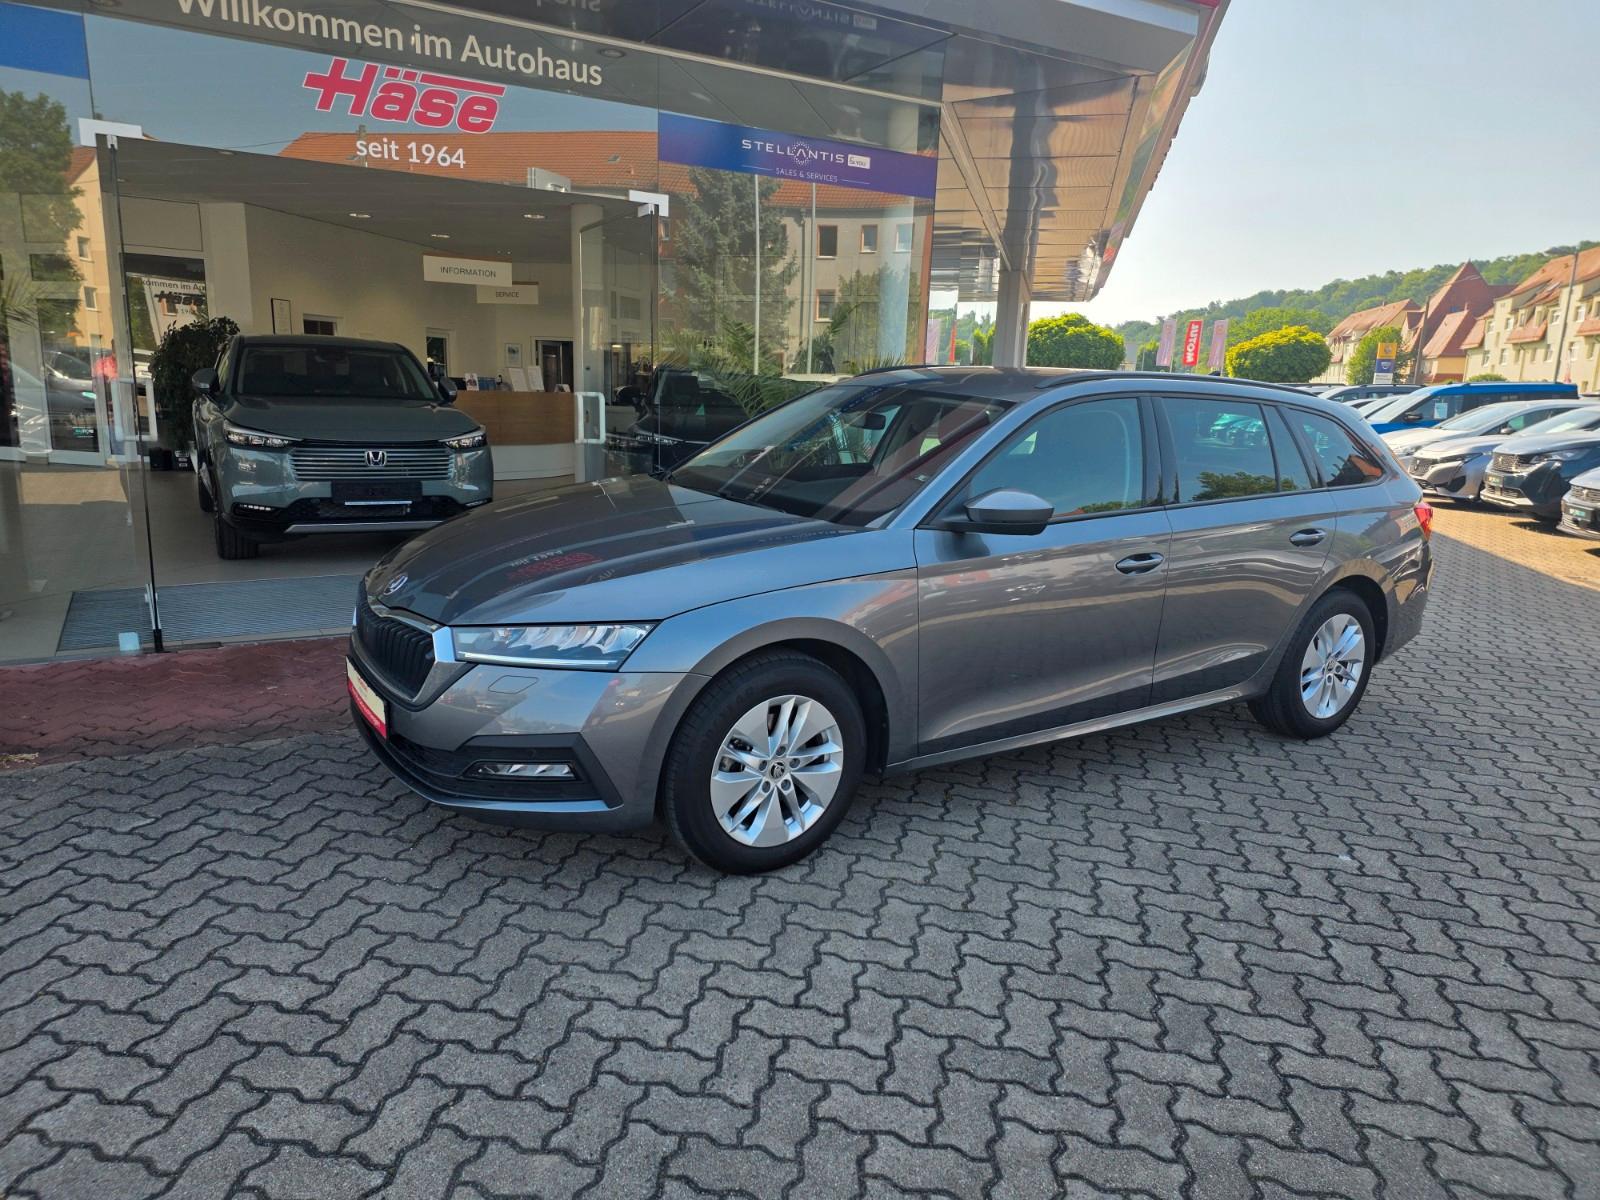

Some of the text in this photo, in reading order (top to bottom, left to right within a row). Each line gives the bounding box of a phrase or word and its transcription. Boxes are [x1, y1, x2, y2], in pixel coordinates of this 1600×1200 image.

[413, 24, 452, 60] im
[460, 34, 602, 86] Autohaus
[302, 56, 506, 134] Häse
[356, 137, 466, 168] seit 1964
[742, 139, 845, 164] STELLANTIS
[775, 167, 798, 177] SALES
[806, 171, 838, 183] SERVICES
[440, 266, 497, 278] INFORMATION
